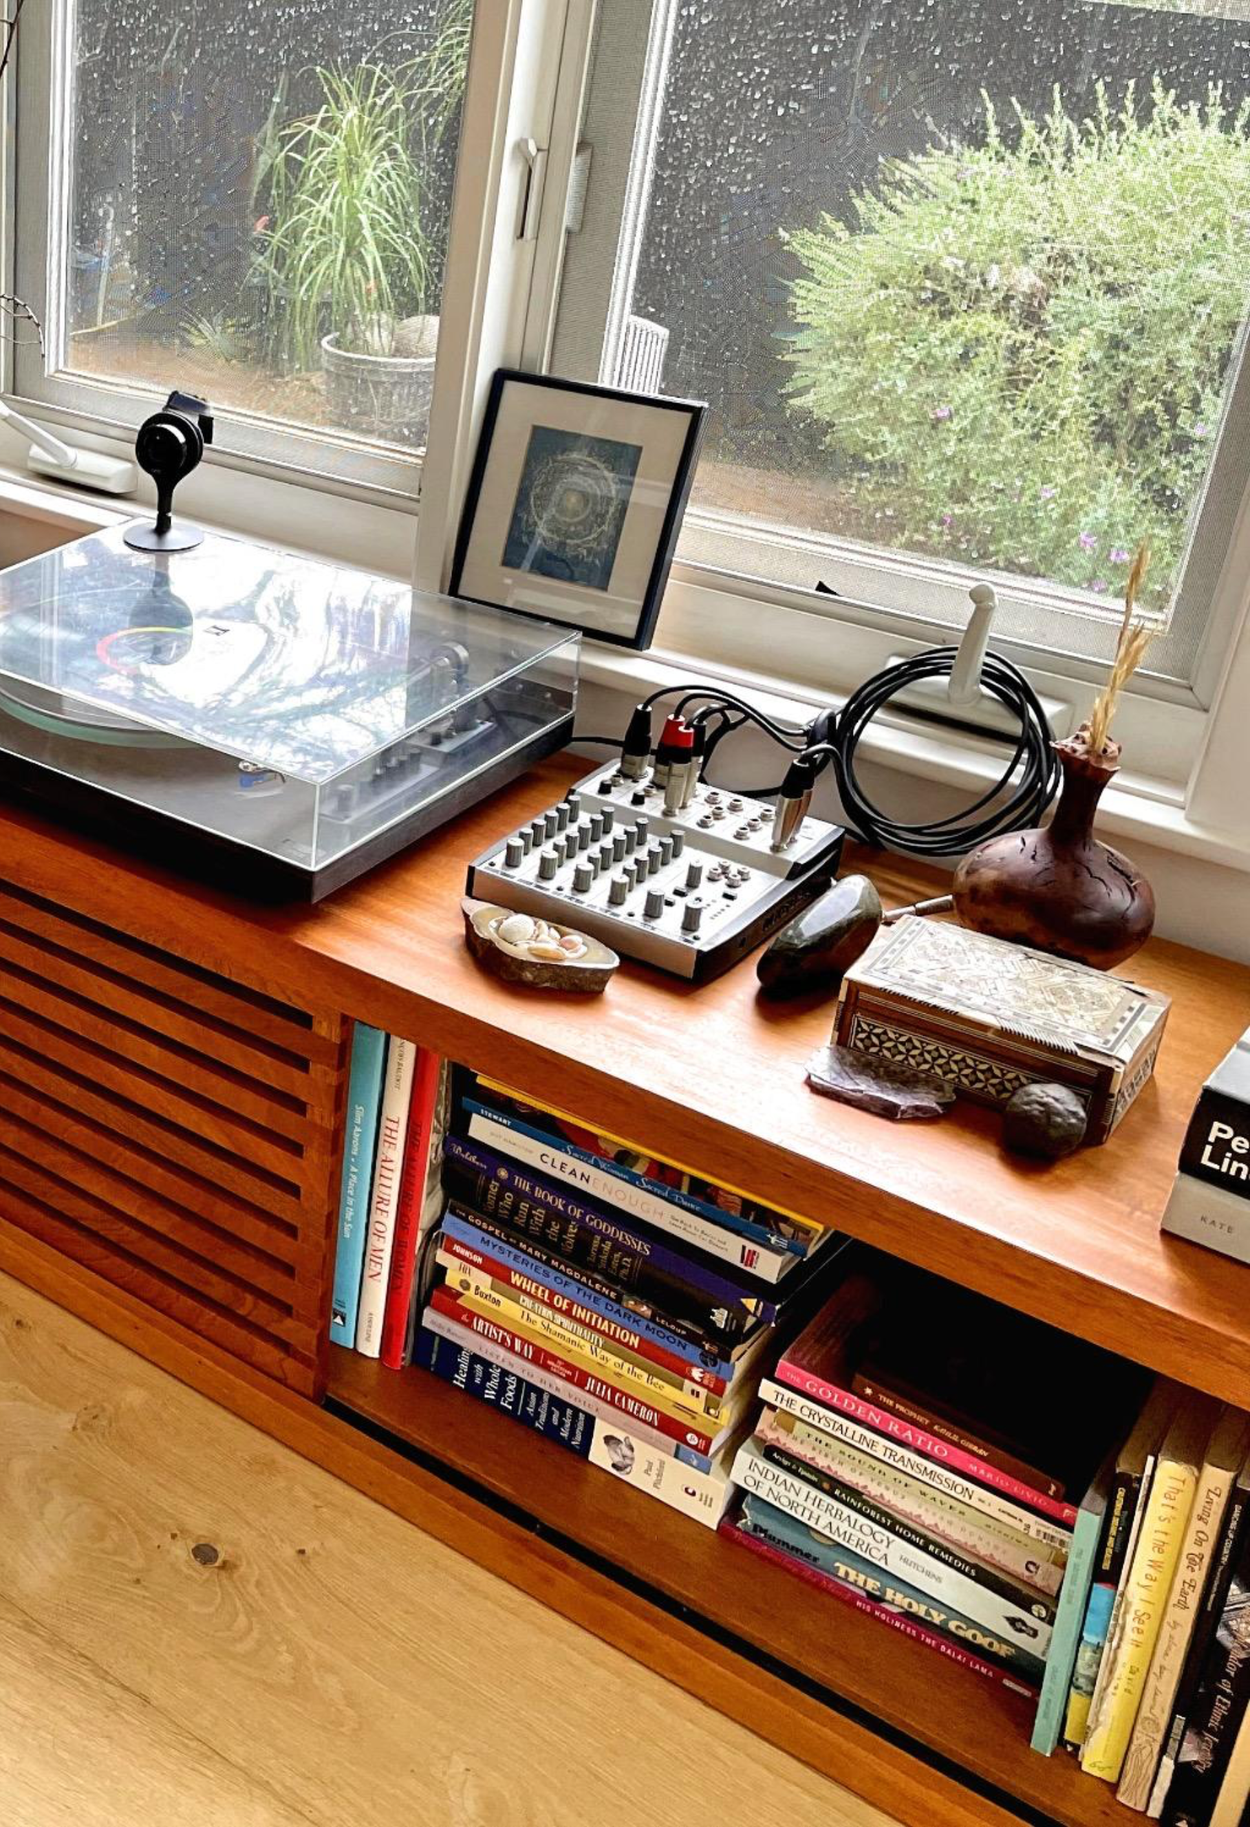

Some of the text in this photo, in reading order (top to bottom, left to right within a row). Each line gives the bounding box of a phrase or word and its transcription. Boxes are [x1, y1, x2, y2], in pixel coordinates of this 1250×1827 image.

[354, 1105, 364, 1125] Slim
[481, 1109, 511, 1126] STEWART
[351, 1126, 362, 1155] Aarons
[1201, 1144, 1250, 1181] Lin
[347, 1173, 357, 1195] Place
[368, 1116, 400, 1282] THE ALLURE OF MEN
[540, 1152, 664, 1219] CLEAN ENOUGH
[343, 1222, 352, 1239] Sun
[346, 1206, 354, 1222] the
[513, 1175, 651, 1256] THE BOOK OF GODDESSES
[514, 1202, 529, 1227] Run
[1201, 1215, 1234, 1234] KATE
[468, 1215, 507, 1241] GOSPEL
[519, 1242, 548, 1262] MARY
[551, 1259, 618, 1300] MAGDALENE
[453, 1243, 640, 1349] JOHNSON WHEEL OF INITIATION
[480, 1236, 688, 1351] MYSTERIES OF THE DARK MOON
[471, 1317, 512, 1348] ARTIST'S
[514, 1334, 535, 1360] WAY
[474, 1285, 665, 1391] Buxton The Shamanic Way of the Bee
[453, 1347, 474, 1389] Healing
[475, 1364, 484, 1384] with
[484, 1364, 501, 1400] Whole
[500, 1375, 517, 1411] Foods
[526, 1392, 537, 1417] Asian
[585, 1377, 659, 1427] JULIA CAMERON
[878, 1393, 893, 1407] THE
[894, 1403, 930, 1426] PROPHET
[551, 1407, 560, 1425] and
[560, 1408, 574, 1440] Modern
[773, 1389, 974, 1500] THE CRYSTALLINE TRANSMISSION
[786, 1371, 801, 1383] THE
[805, 1380, 882, 1425] GOLDEN
[888, 1423, 948, 1457] RATIO
[969, 1462, 1010, 1488] MARIO
[1014, 1485, 1047, 1506] LIVIO
[806, 1433, 832, 1447] THE
[839, 1449, 886, 1477] SOUND
[893, 1477, 912, 1488] OF
[919, 1490, 965, 1516] WAVES
[748, 1458, 896, 1549] INDIAN HERBALOGY
[1159, 1475, 1185, 1523] That's
[1196, 1486, 1222, 1526] Living
[743, 1475, 890, 1567] OF NORTH AMERICA
[834, 1488, 894, 1527] RAINFOREST
[895, 1521, 925, 1547] HOME
[928, 1544, 977, 1577] REMEDIES
[1193, 1530, 1209, 1547] On
[1151, 1530, 1172, 1555] the
[899, 1554, 943, 1583] HUTCHENS
[1137, 1559, 1164, 1591] Way
[1186, 1552, 1204, 1573] The
[752, 1523, 820, 1564] Plummer
[834, 1562, 881, 1594] THE
[885, 1587, 947, 1624] HOLY
[948, 1620, 1016, 1658] GOOF
[1173, 1579, 1197, 1611] Earth
[856, 1601, 994, 1678] HIS HOLINESS THE DALAI LAMA
[1132, 1609, 1151, 1635] See
[1216, 1679, 1233, 1695] of
[1208, 1695, 1230, 1732] Ethnic
